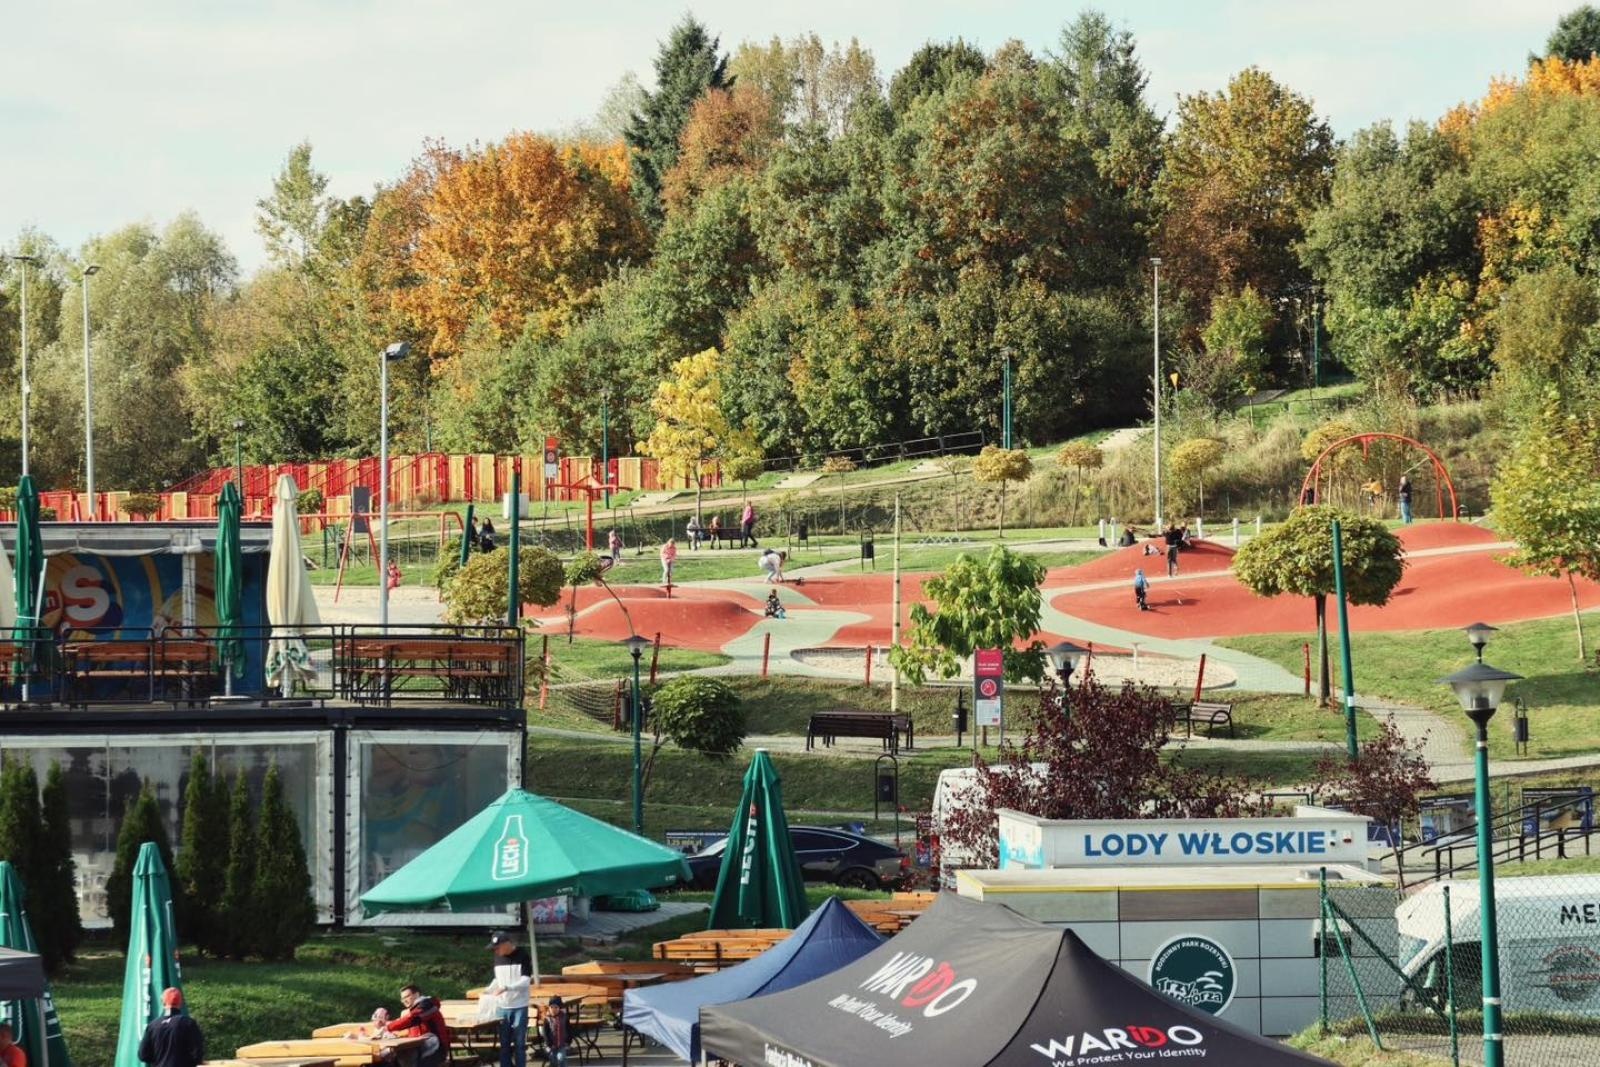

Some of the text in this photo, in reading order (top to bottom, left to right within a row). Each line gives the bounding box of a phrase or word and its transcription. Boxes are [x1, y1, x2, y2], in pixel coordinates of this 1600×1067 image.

[1084, 831, 1326, 857] LODY WŁOSKIE
[501, 843, 520, 875] LECH
[1560, 903, 1600, 925] ME
[1155, 940, 1229, 971] RODZINNY PARK ROZRYWKI
[1077, 1053, 1122, 1066] Protect
[1125, 1050, 1156, 1060] Your
[1158, 1047, 1207, 1058] Identity
